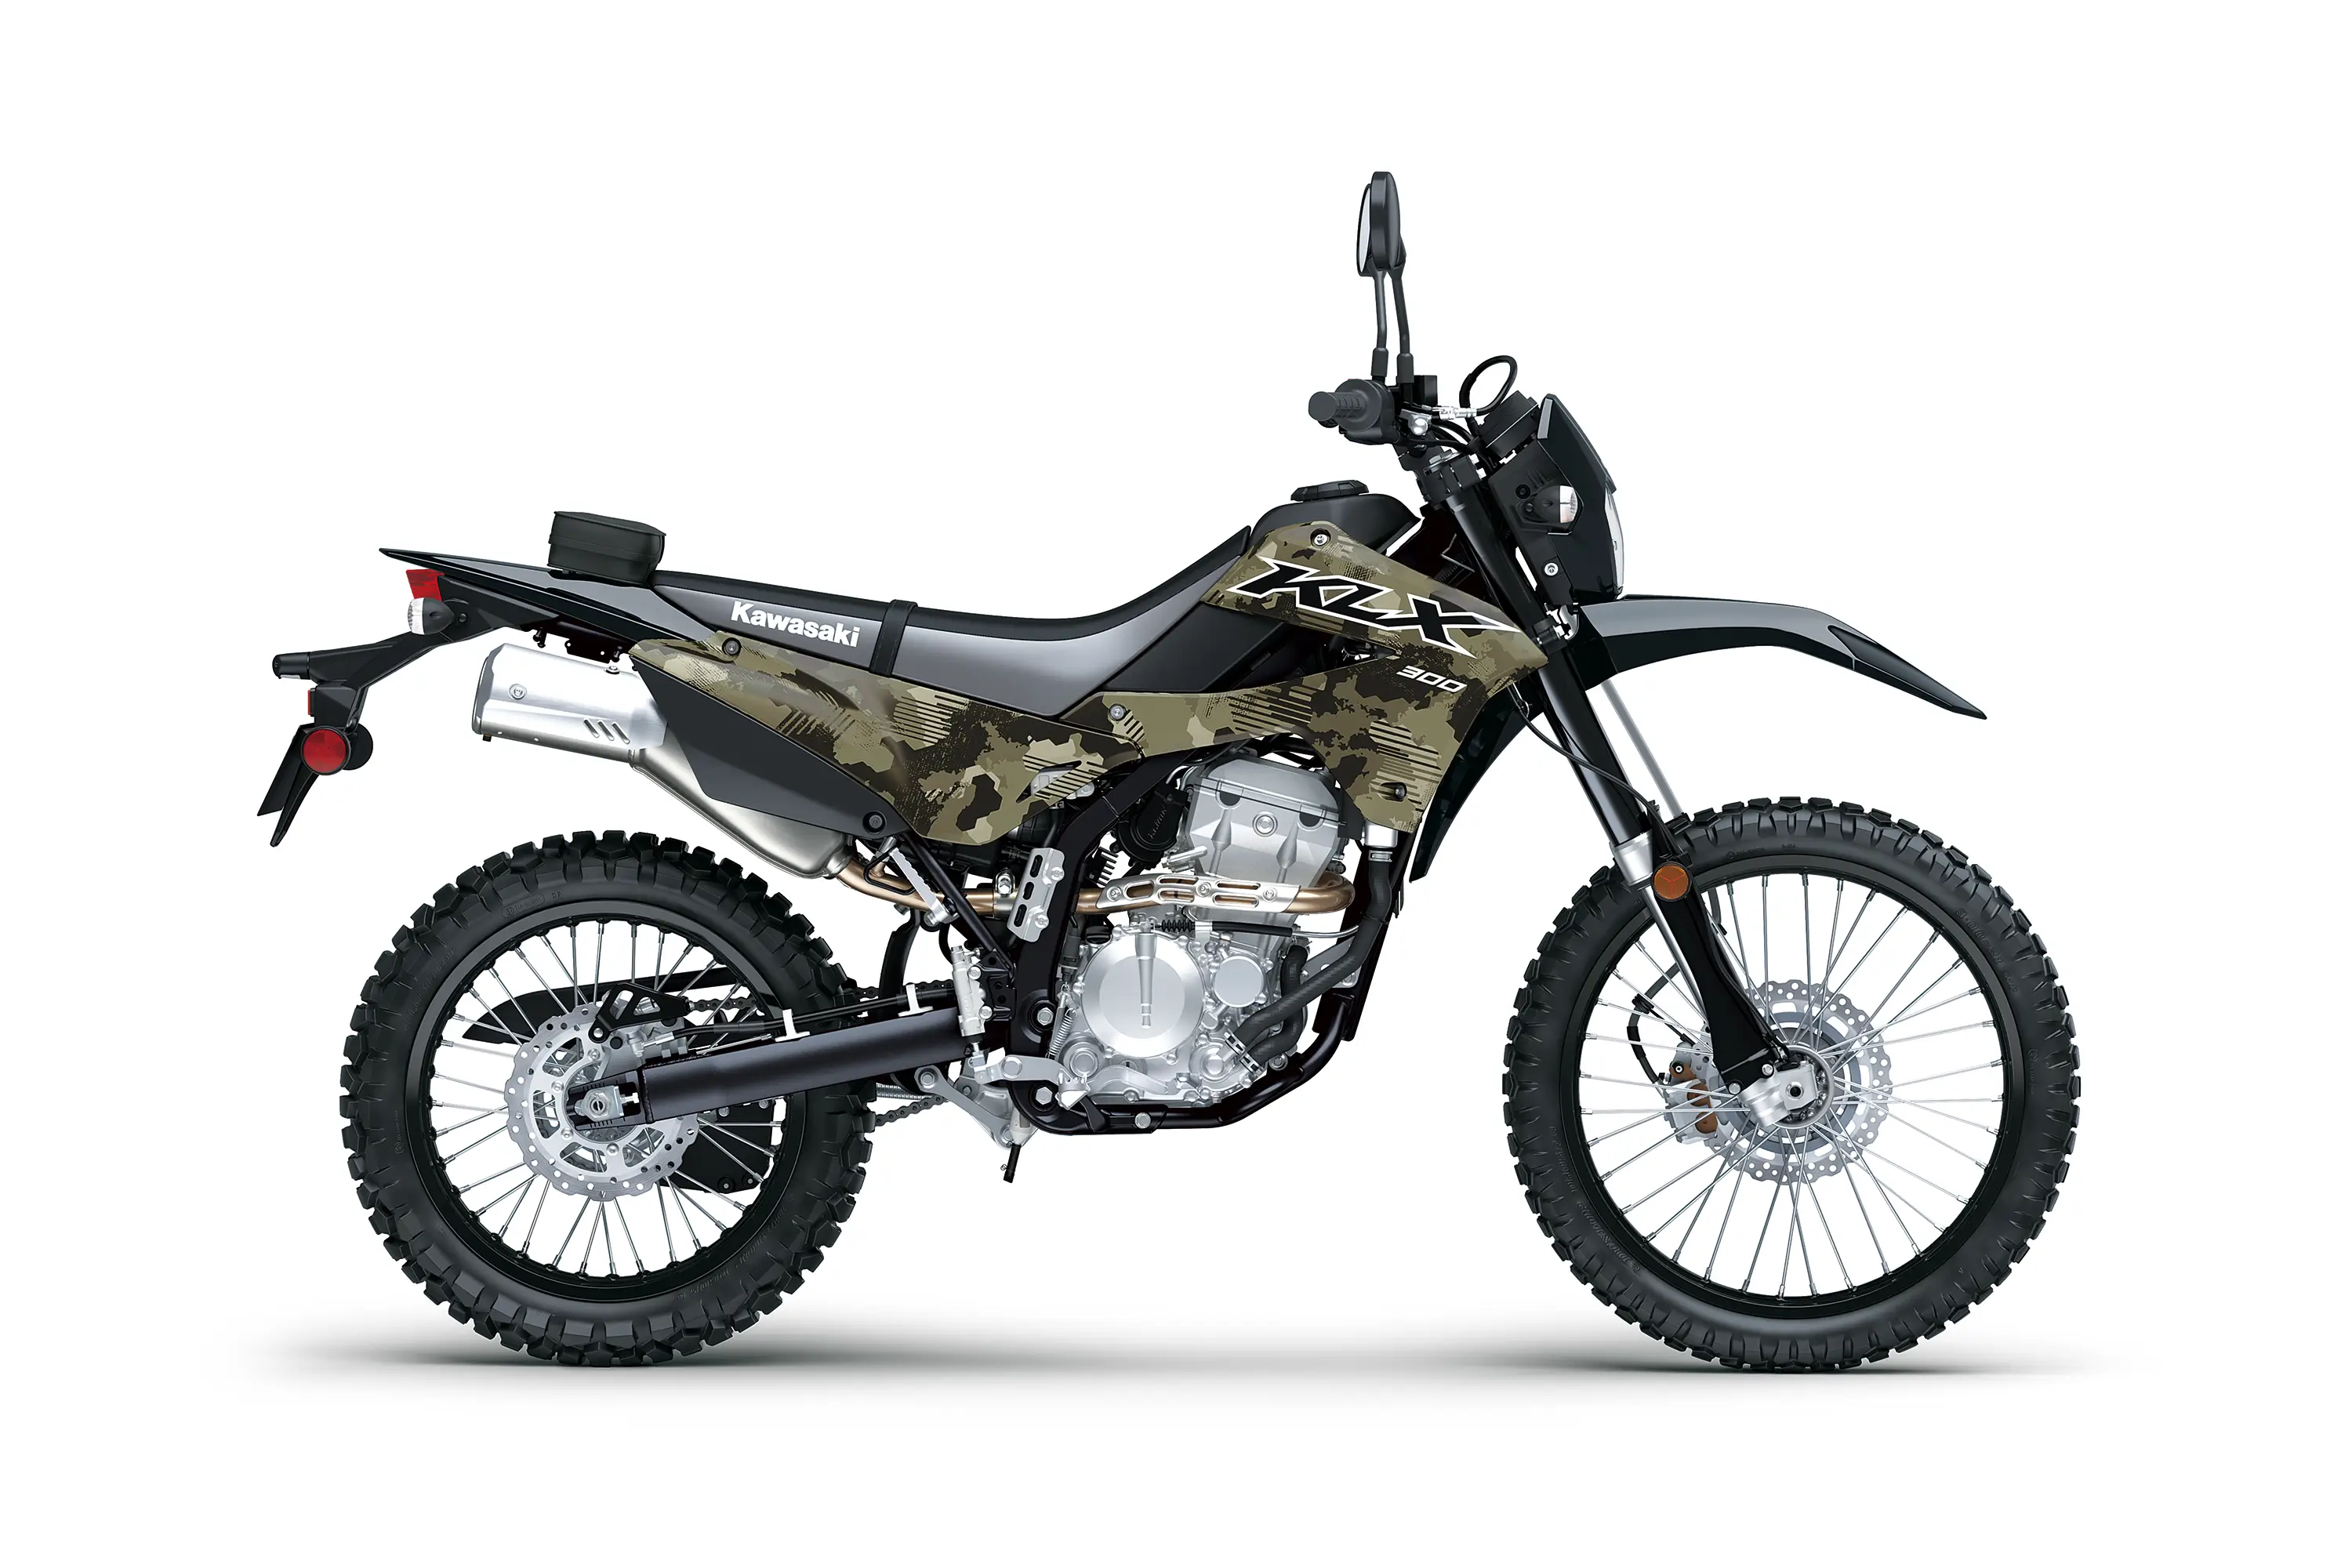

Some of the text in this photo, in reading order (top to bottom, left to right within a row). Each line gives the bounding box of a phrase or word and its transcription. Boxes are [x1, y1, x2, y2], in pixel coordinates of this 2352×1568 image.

[731, 601, 861, 648] Kawasaki
[1225, 556, 1521, 659] KLX
[1396, 665, 1468, 692] 300
